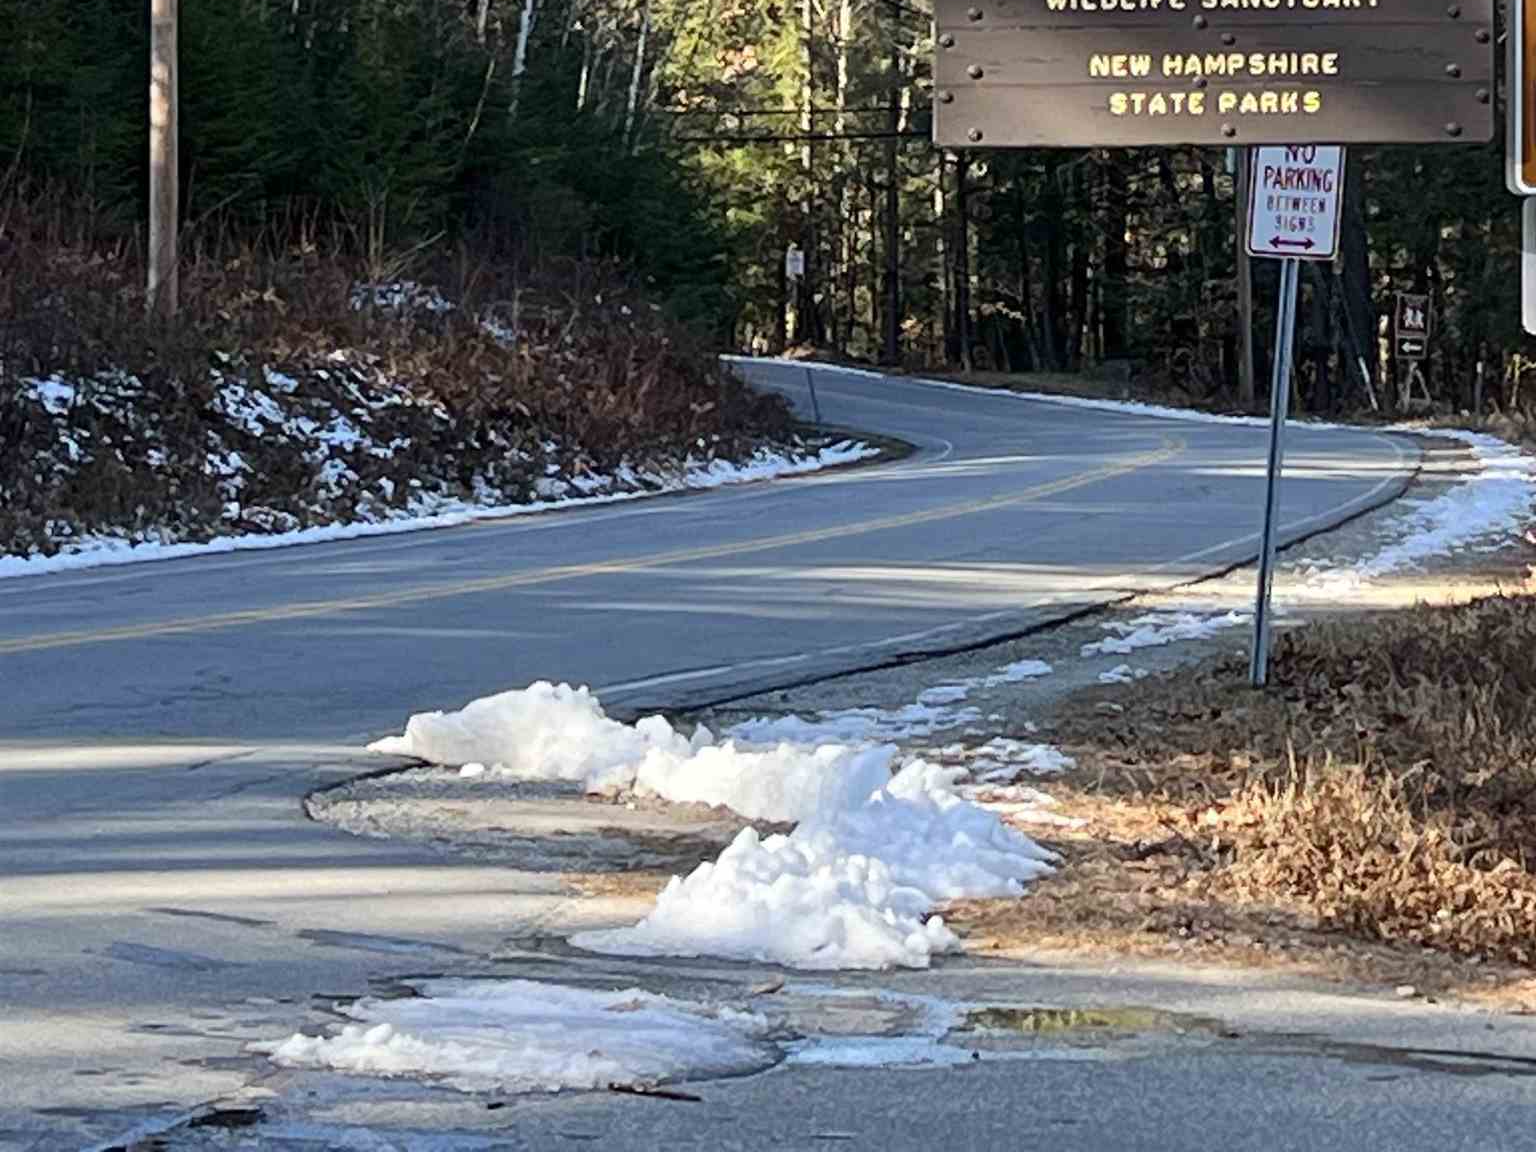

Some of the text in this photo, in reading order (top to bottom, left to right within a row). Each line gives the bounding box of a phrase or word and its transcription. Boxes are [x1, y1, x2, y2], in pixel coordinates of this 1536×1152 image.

[1089, 52, 1338, 77] NEW HAMPSHIRE
[1109, 91, 1321, 114] STATE PARKS
[1285, 145, 1316, 164] NO
[1264, 166, 1333, 192] PARKING
[1266, 196, 1326, 213] BETWEEN
